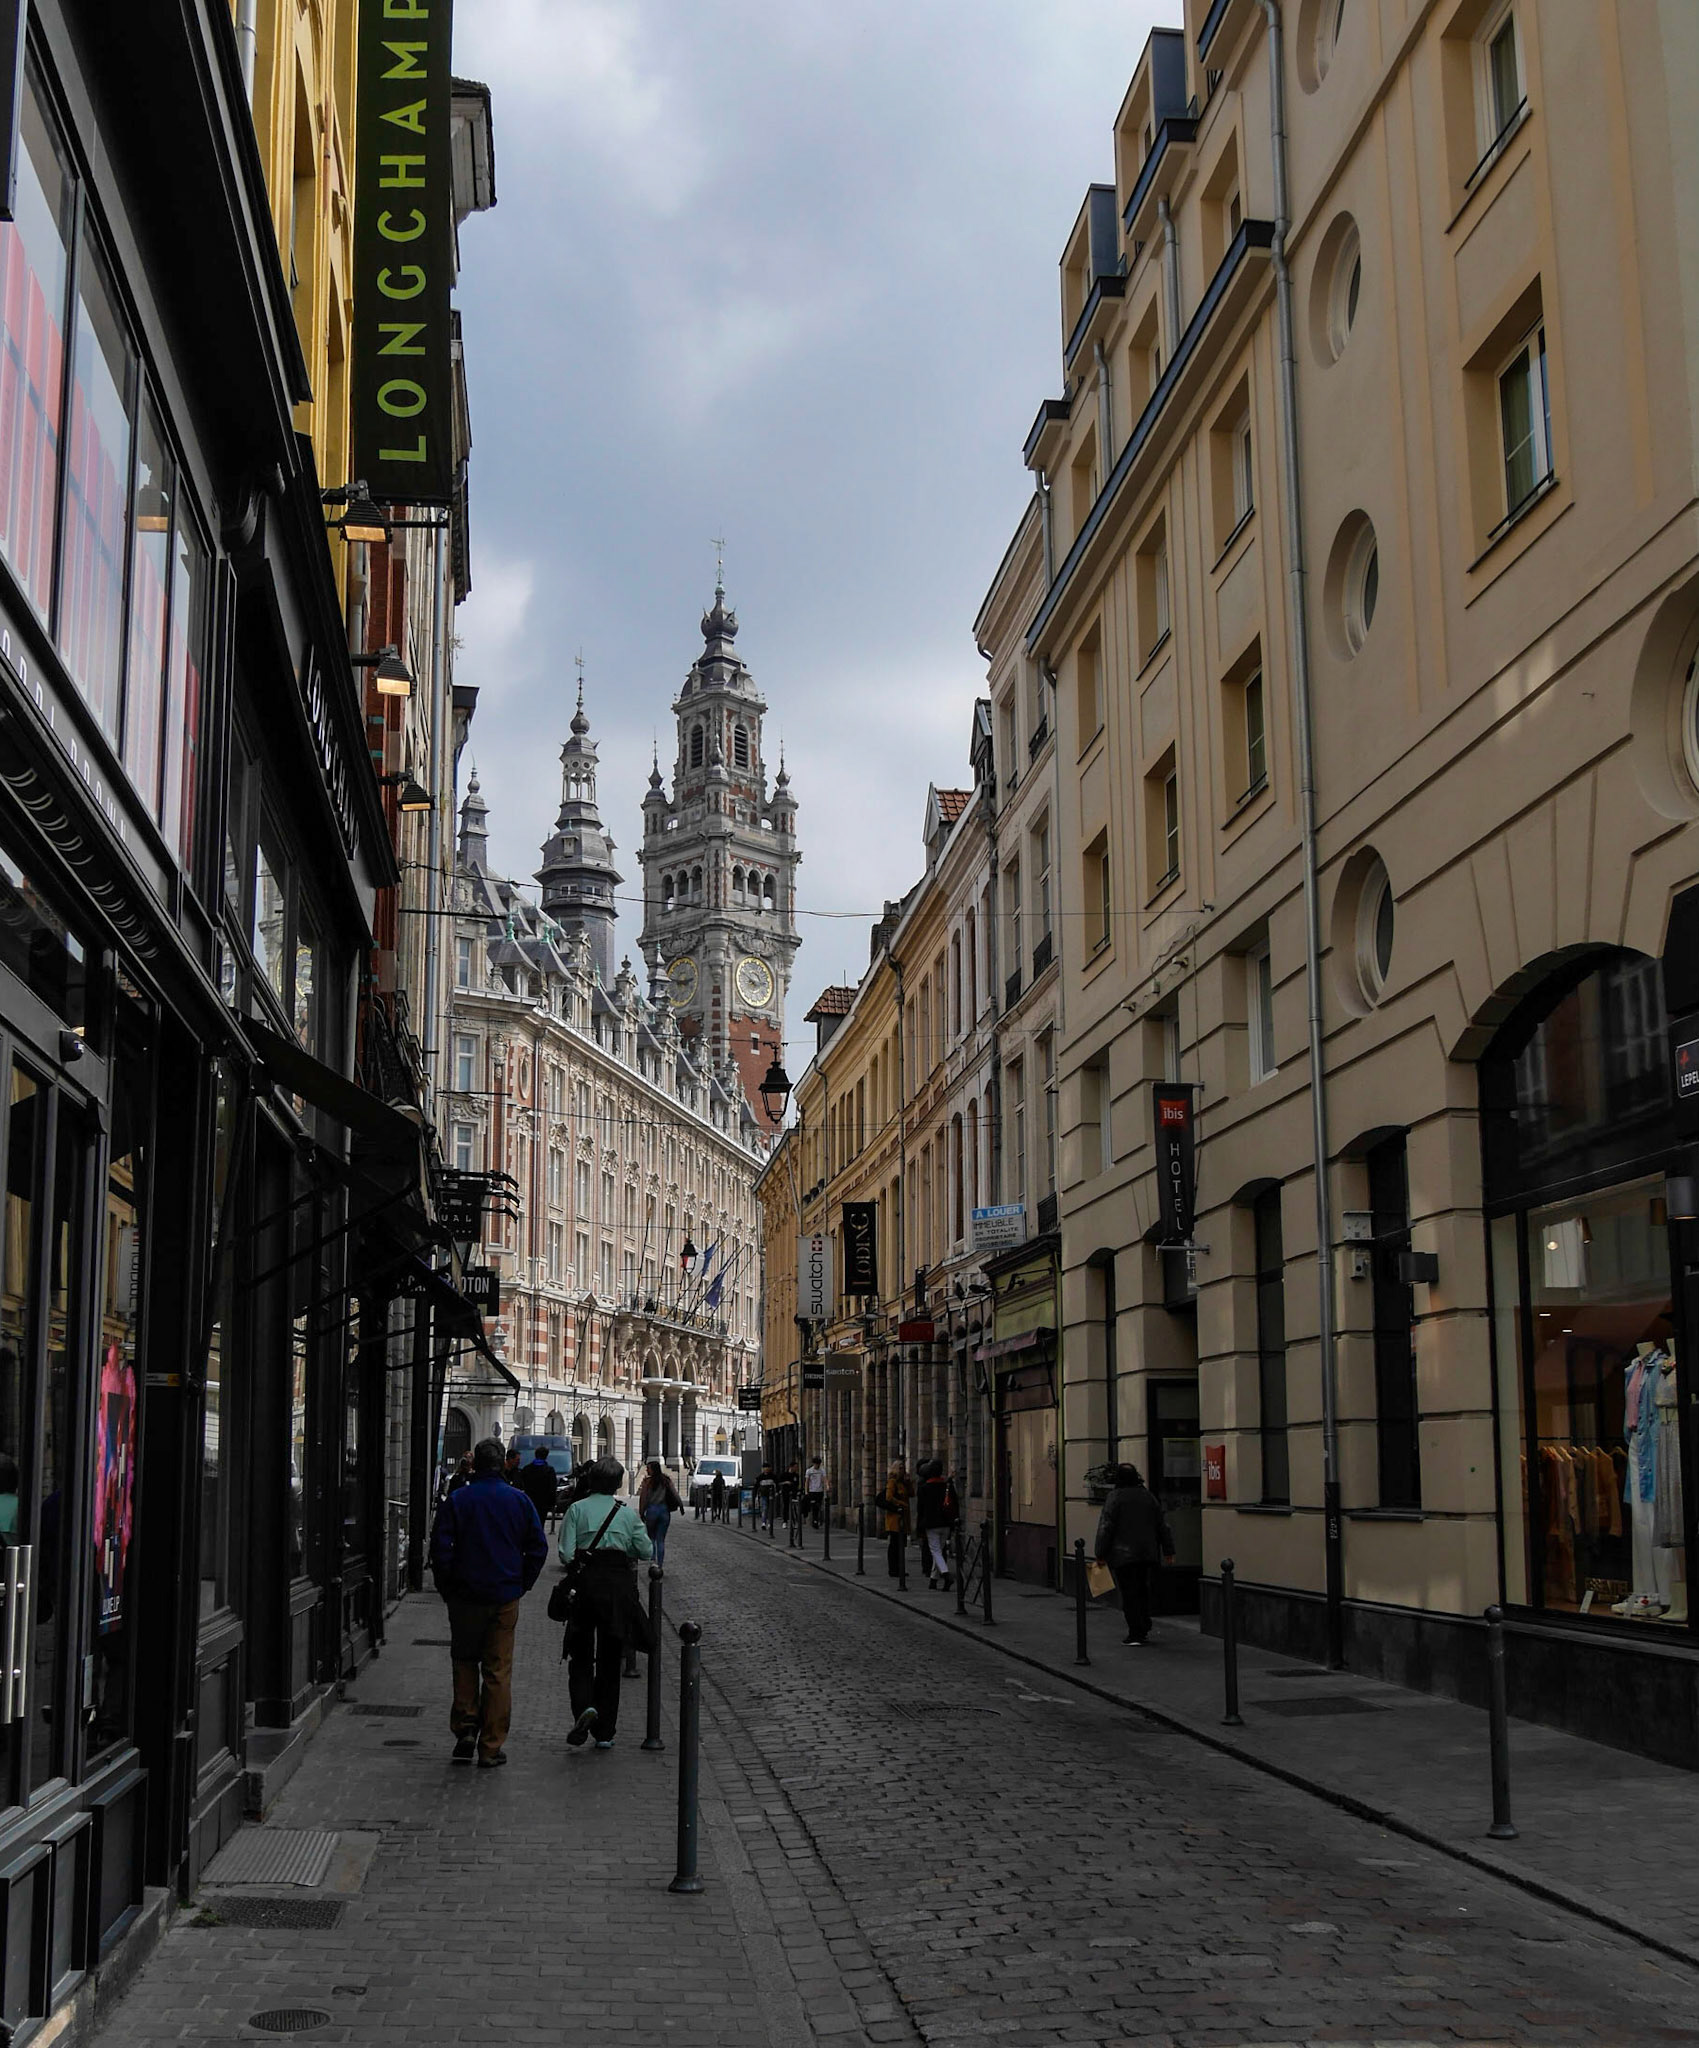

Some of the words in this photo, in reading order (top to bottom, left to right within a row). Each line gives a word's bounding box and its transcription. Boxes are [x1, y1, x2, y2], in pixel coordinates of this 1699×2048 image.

[1163, 1107, 1184, 1120] ibis
[1169, 1142, 1184, 1231] HOTEL
[976, 1210, 983, 1219] A
[987, 1206, 1019, 1217] LOUER
[809, 1252, 824, 1315] swatch
[1208, 1459, 1221, 1481] ibis
